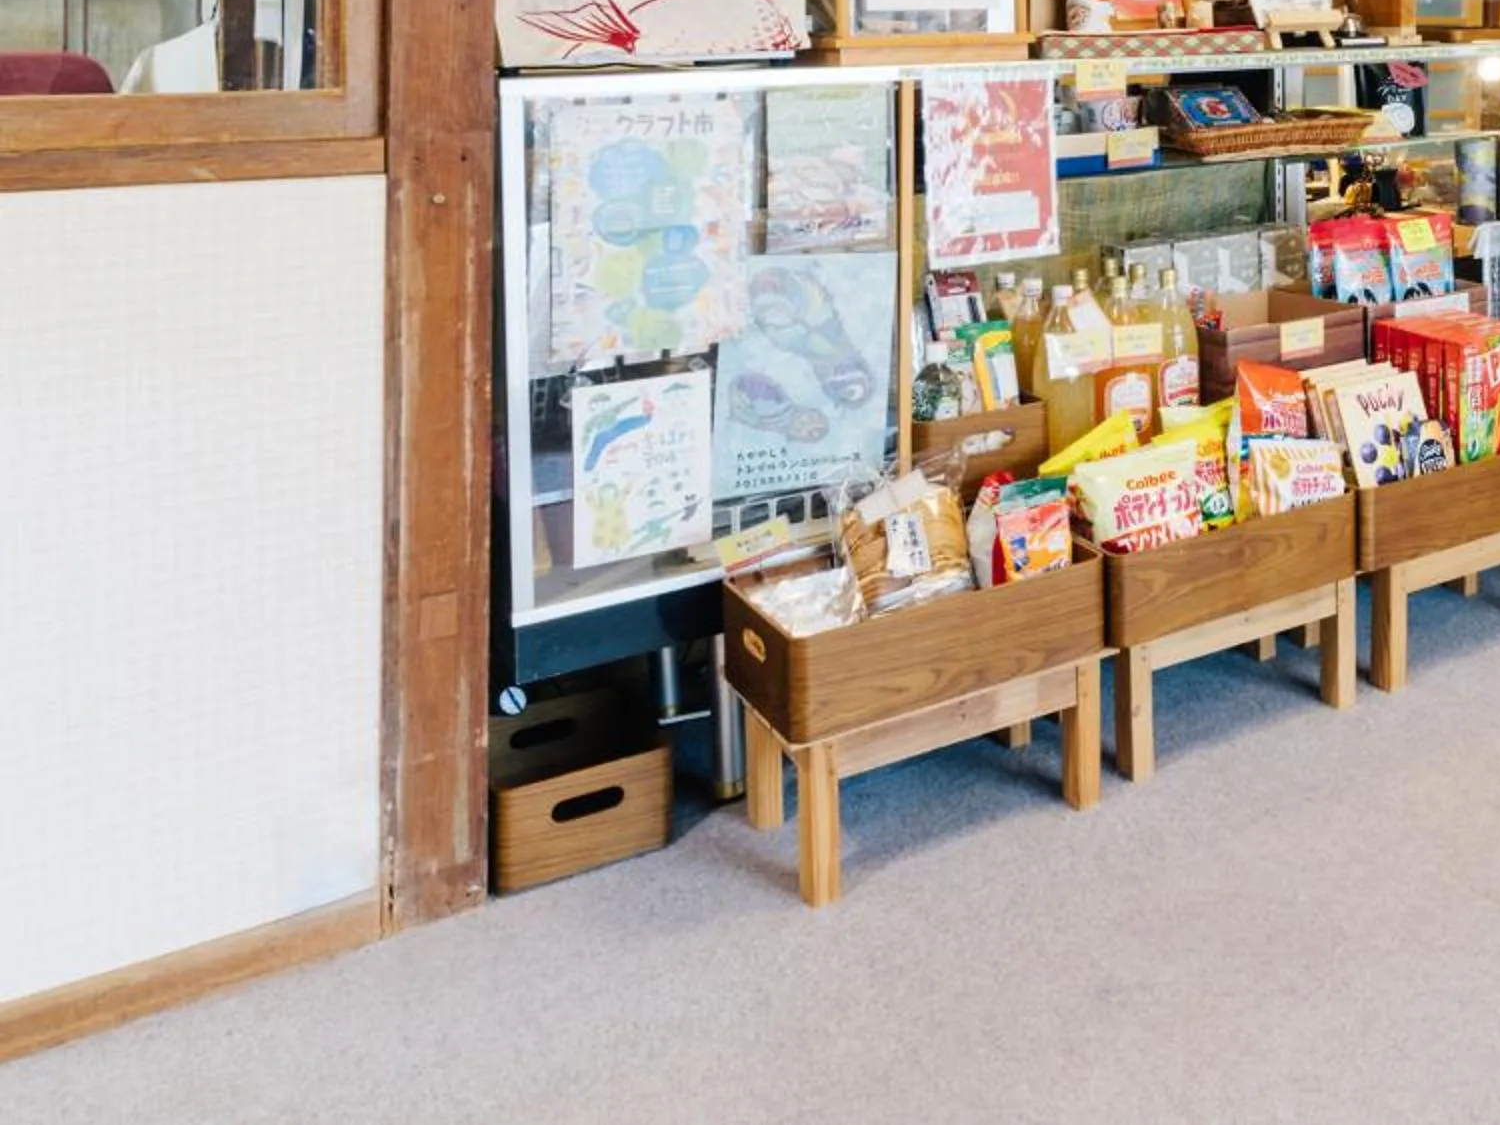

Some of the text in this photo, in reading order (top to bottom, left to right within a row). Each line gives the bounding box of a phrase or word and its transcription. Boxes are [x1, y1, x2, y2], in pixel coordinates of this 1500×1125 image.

[615, 109, 714, 136] クラフト市
[1126, 470, 1176, 491] Calbee
